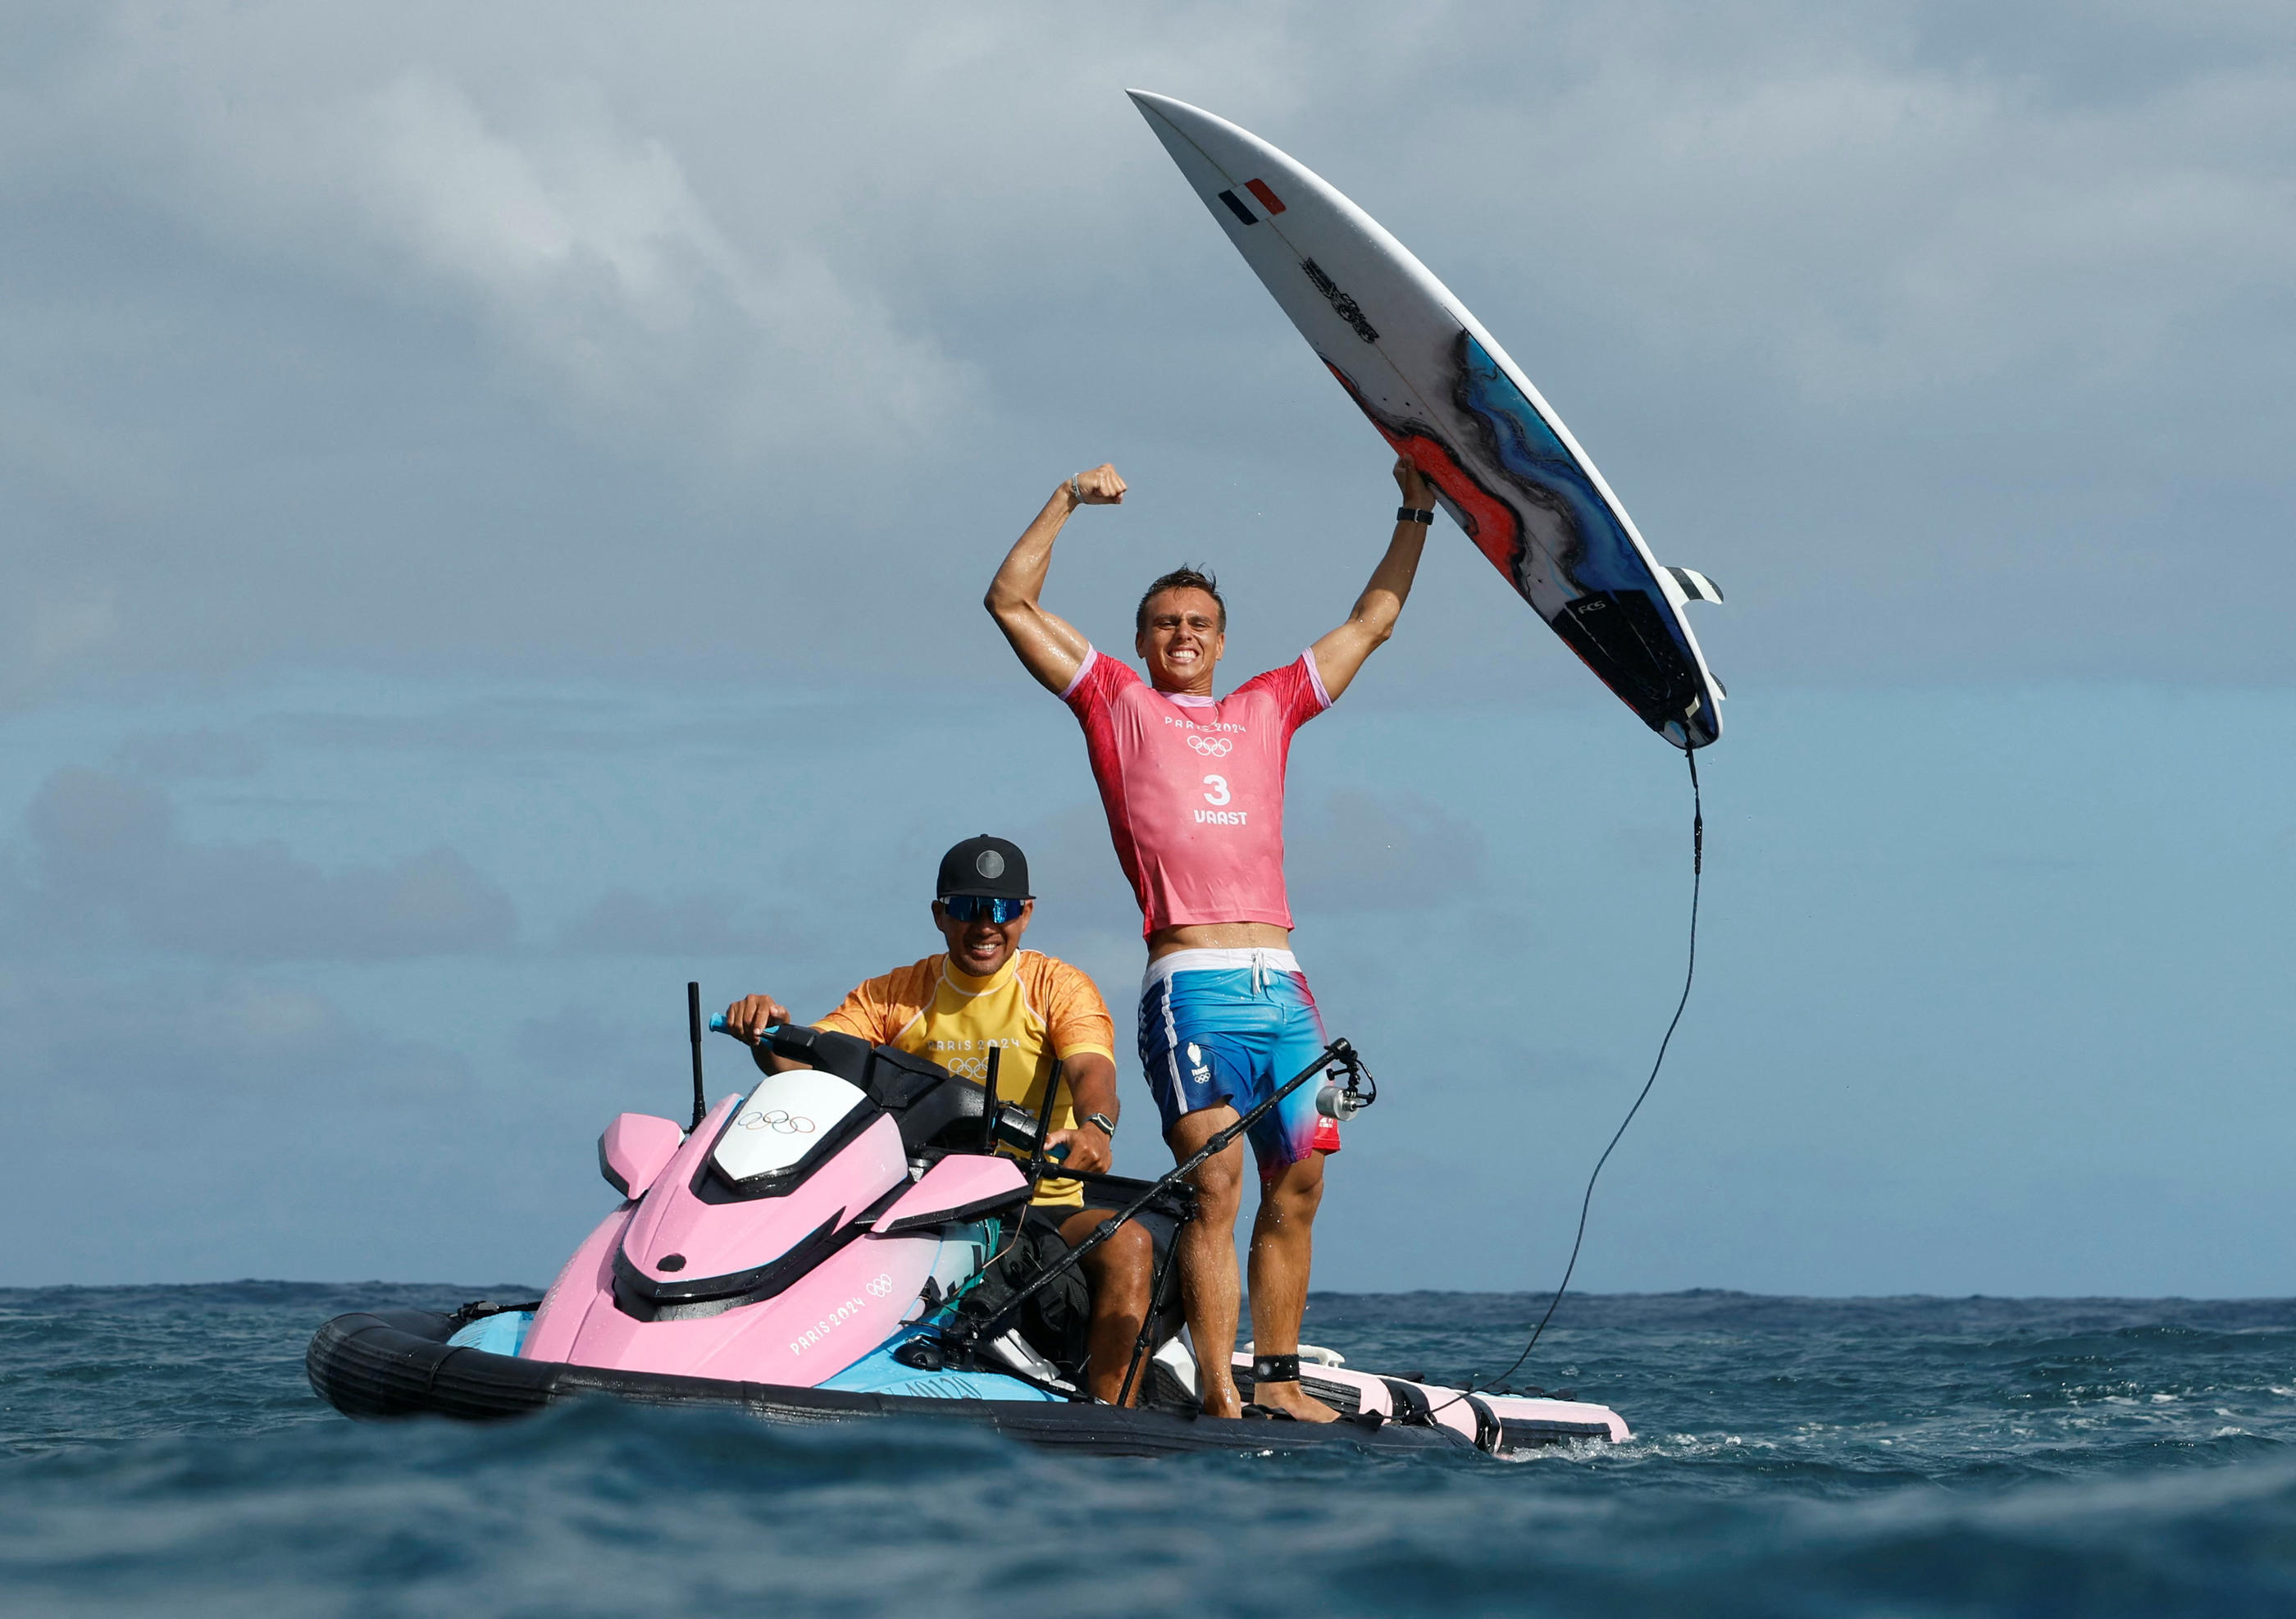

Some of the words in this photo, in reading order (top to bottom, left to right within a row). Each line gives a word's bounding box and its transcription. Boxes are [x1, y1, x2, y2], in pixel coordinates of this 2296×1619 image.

[1578, 600, 1606, 614] FCS
[1203, 774, 1231, 805] 3
[1193, 809, 1247, 825] VAAST
[829, 1297, 865, 1325] 2024
